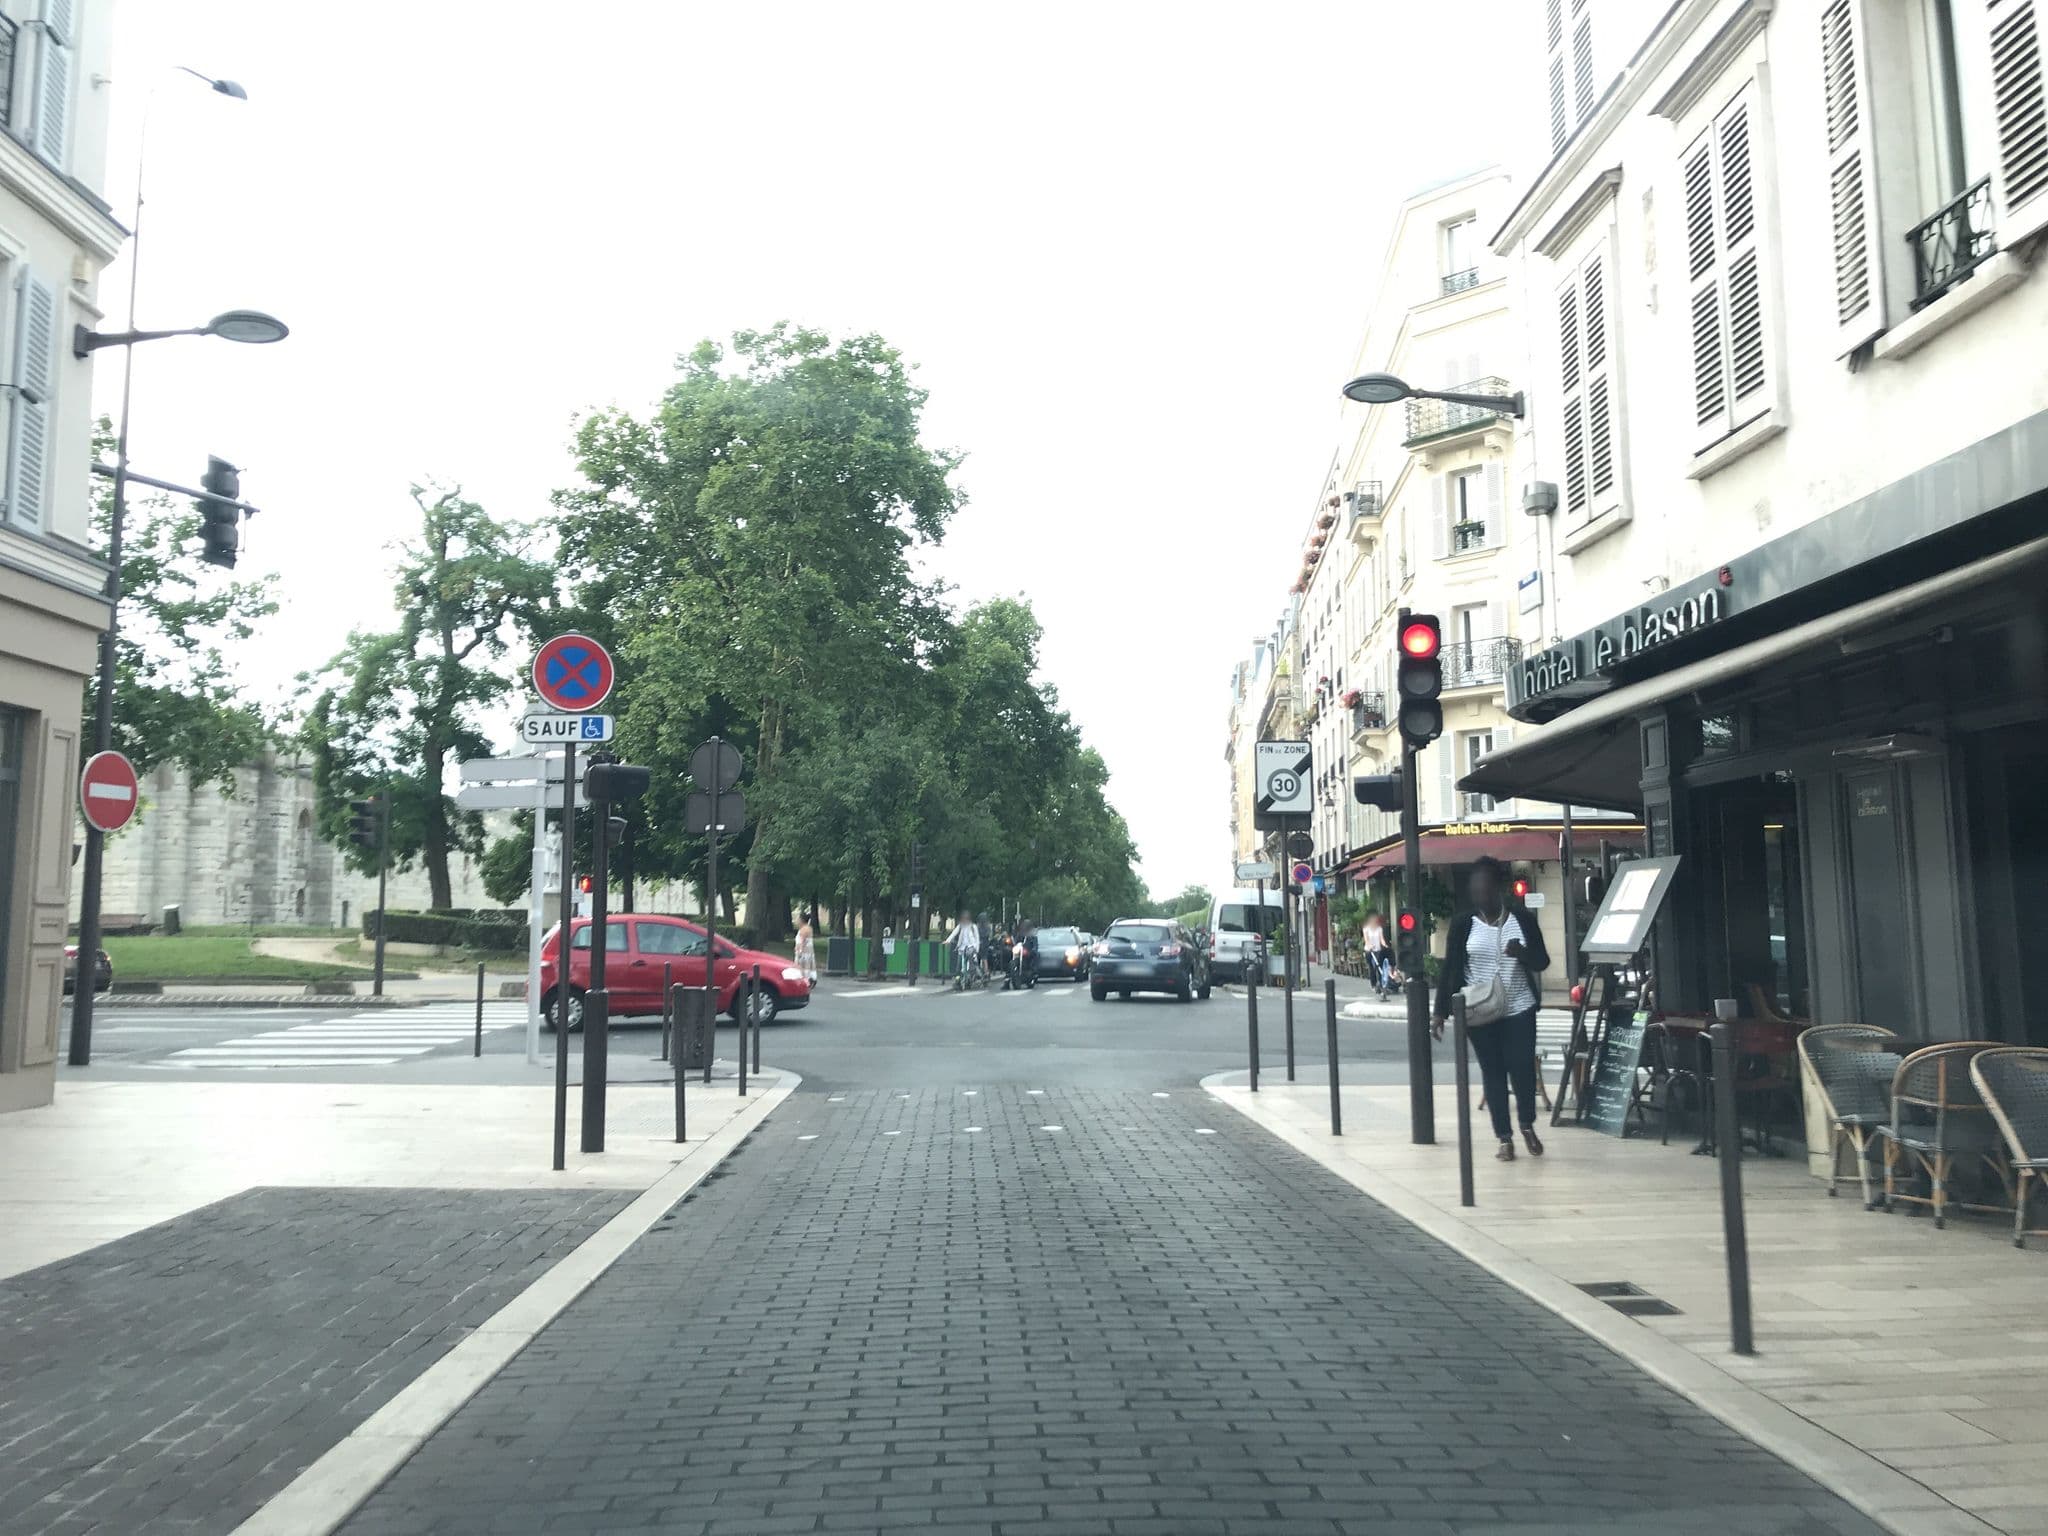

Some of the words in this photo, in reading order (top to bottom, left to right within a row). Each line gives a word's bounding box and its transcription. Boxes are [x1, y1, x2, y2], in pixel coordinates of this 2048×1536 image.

[1522, 640, 1578, 698] hôtel
[1592, 630, 1613, 670] le
[1621, 587, 1719, 657] blason
[528, 721, 578, 736] SAUF
[1274, 778, 1294, 792] 30
[1445, 823, 1480, 835] Reflets
[1481, 822, 1510, 833] Fleurs
